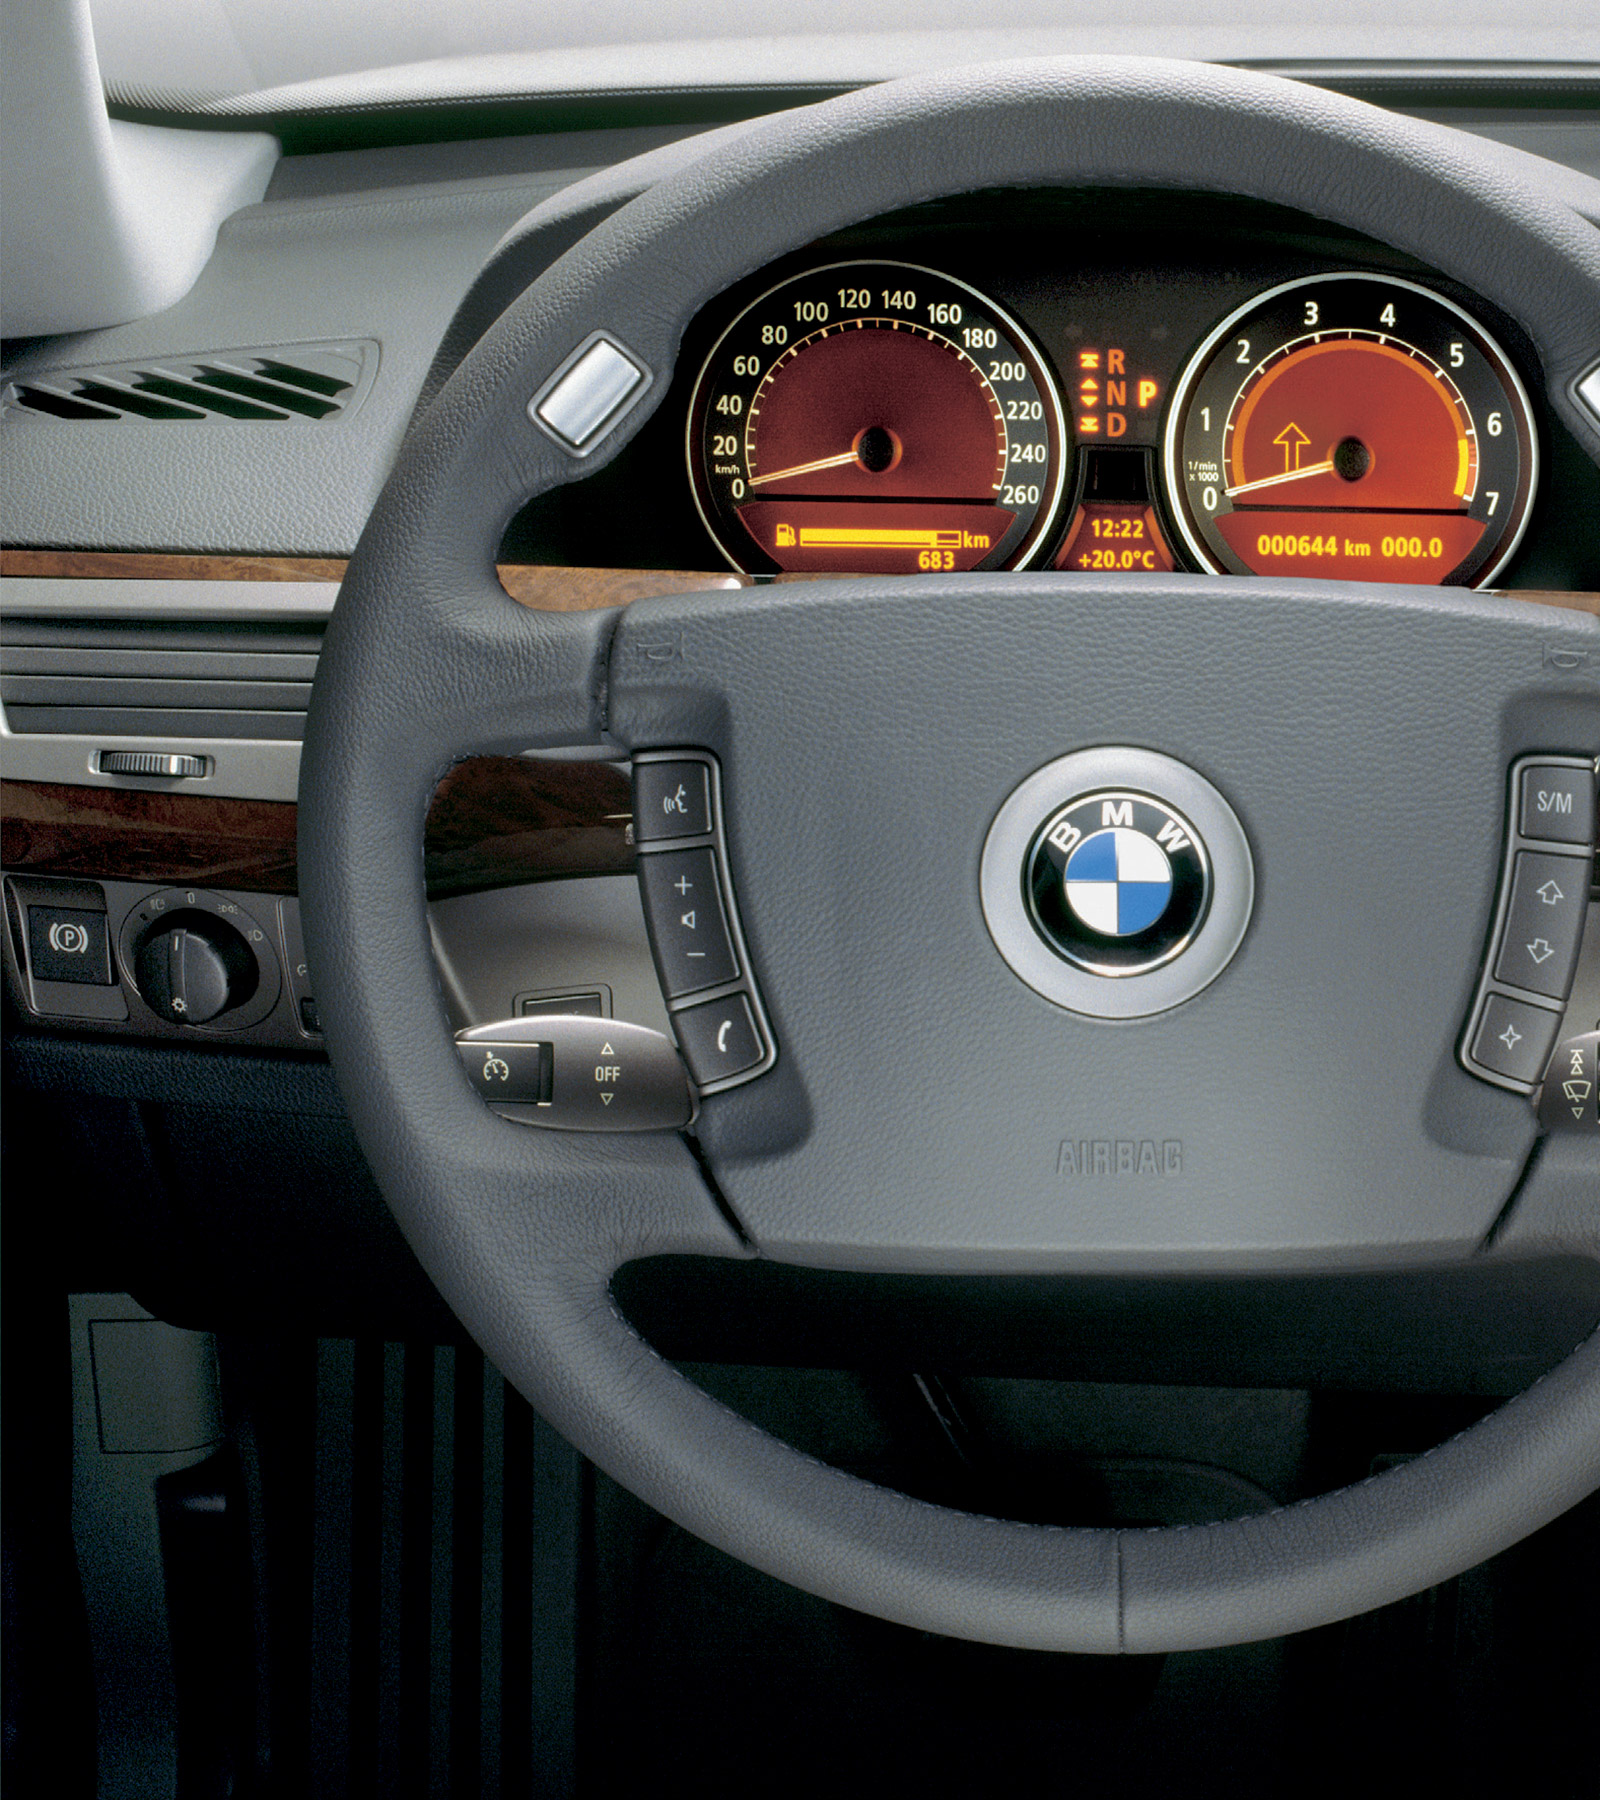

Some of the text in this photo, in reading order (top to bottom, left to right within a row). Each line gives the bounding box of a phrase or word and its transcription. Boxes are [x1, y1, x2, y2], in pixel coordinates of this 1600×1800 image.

[838, 289, 870, 309] 120
[881, 290, 916, 310] 140
[794, 301, 829, 322] 100
[927, 303, 962, 325] 160
[1304, 302, 1319, 326] 3
[1380, 303, 1396, 327] 4
[761, 325, 788, 345] 80
[962, 328, 997, 349] 180
[1107, 348, 1125, 375] R
[1236, 339, 1251, 364] 2
[1450, 343, 1464, 368] 5
[733, 356, 760, 376] 60
[989, 361, 1026, 382] 200
[1106, 380, 1126, 406] N
[1139, 380, 1158, 408] P
[716, 395, 742, 416] 40
[1006, 401, 1042, 421] 220
[1107, 412, 1127, 437] D
[1201, 407, 1211, 432] 1
[1487, 412, 1502, 437] 6
[713, 435, 738, 456] 20
[1010, 444, 1046, 464] 240
[714, 463, 740, 476] km/h
[1188, 460, 1218, 473] 1/min
[1198, 471, 1219, 483] 1000
[732, 478, 745, 499] 0
[1003, 485, 1039, 504] 260
[1203, 487, 1218, 511] 0
[1485, 491, 1499, 516] 7
[963, 530, 990, 548] km
[1092, 519, 1144, 540] 12:22
[1257, 534, 1443, 558] 000644 km 000.0
[918, 551, 955, 570] 683
[1536, 792, 1572, 814] S/M
[1049, 801, 1190, 854] BMW
[595, 1066, 620, 1082] OFF
[1055, 1139, 1184, 1176] AIRBAG
